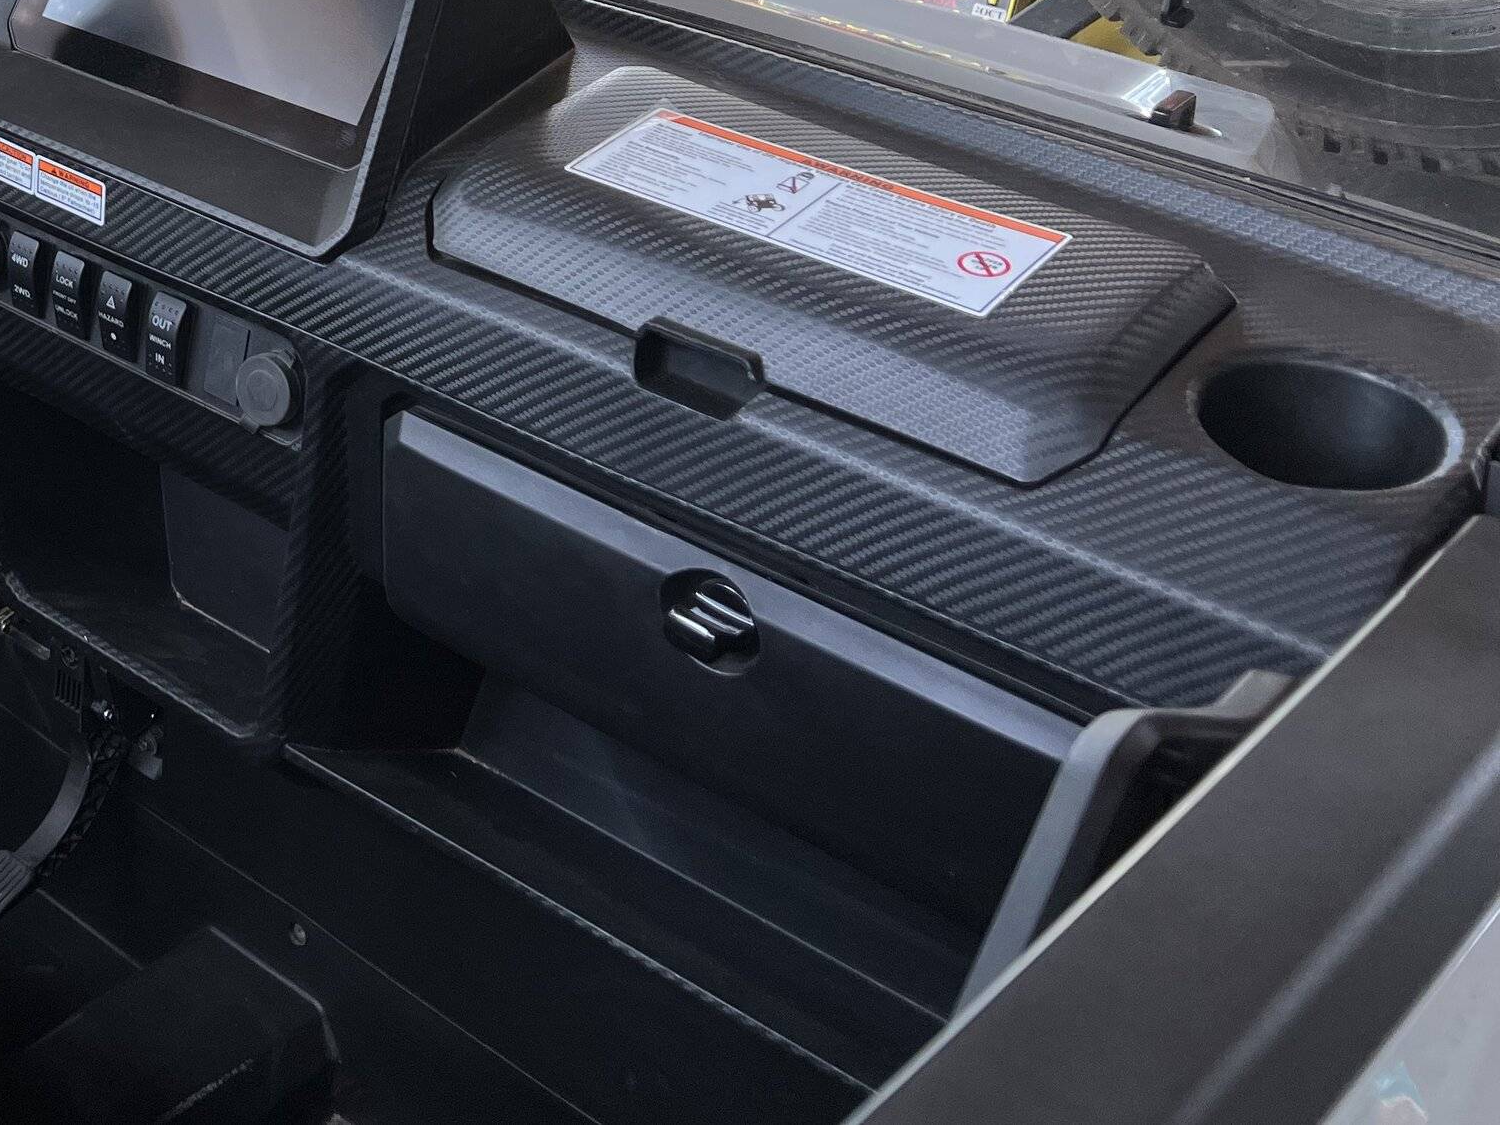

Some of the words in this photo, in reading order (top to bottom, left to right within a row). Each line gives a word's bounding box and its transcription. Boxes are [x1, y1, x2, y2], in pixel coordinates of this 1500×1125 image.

[1, 143, 26, 161] CAUTION
[59, 170, 91, 188] WARNING
[815, 161, 894, 191] WARNING
[10, 252, 30, 268] 4WD
[55, 274, 74, 289] LOCK
[13, 285, 31, 300] 2WD
[54, 303, 79, 321] UNLOCK
[98, 310, 126, 329] HAZARD
[151, 315, 173, 332] OUT
[149, 332, 172, 351] WINCH
[154, 351, 166, 366] IN
